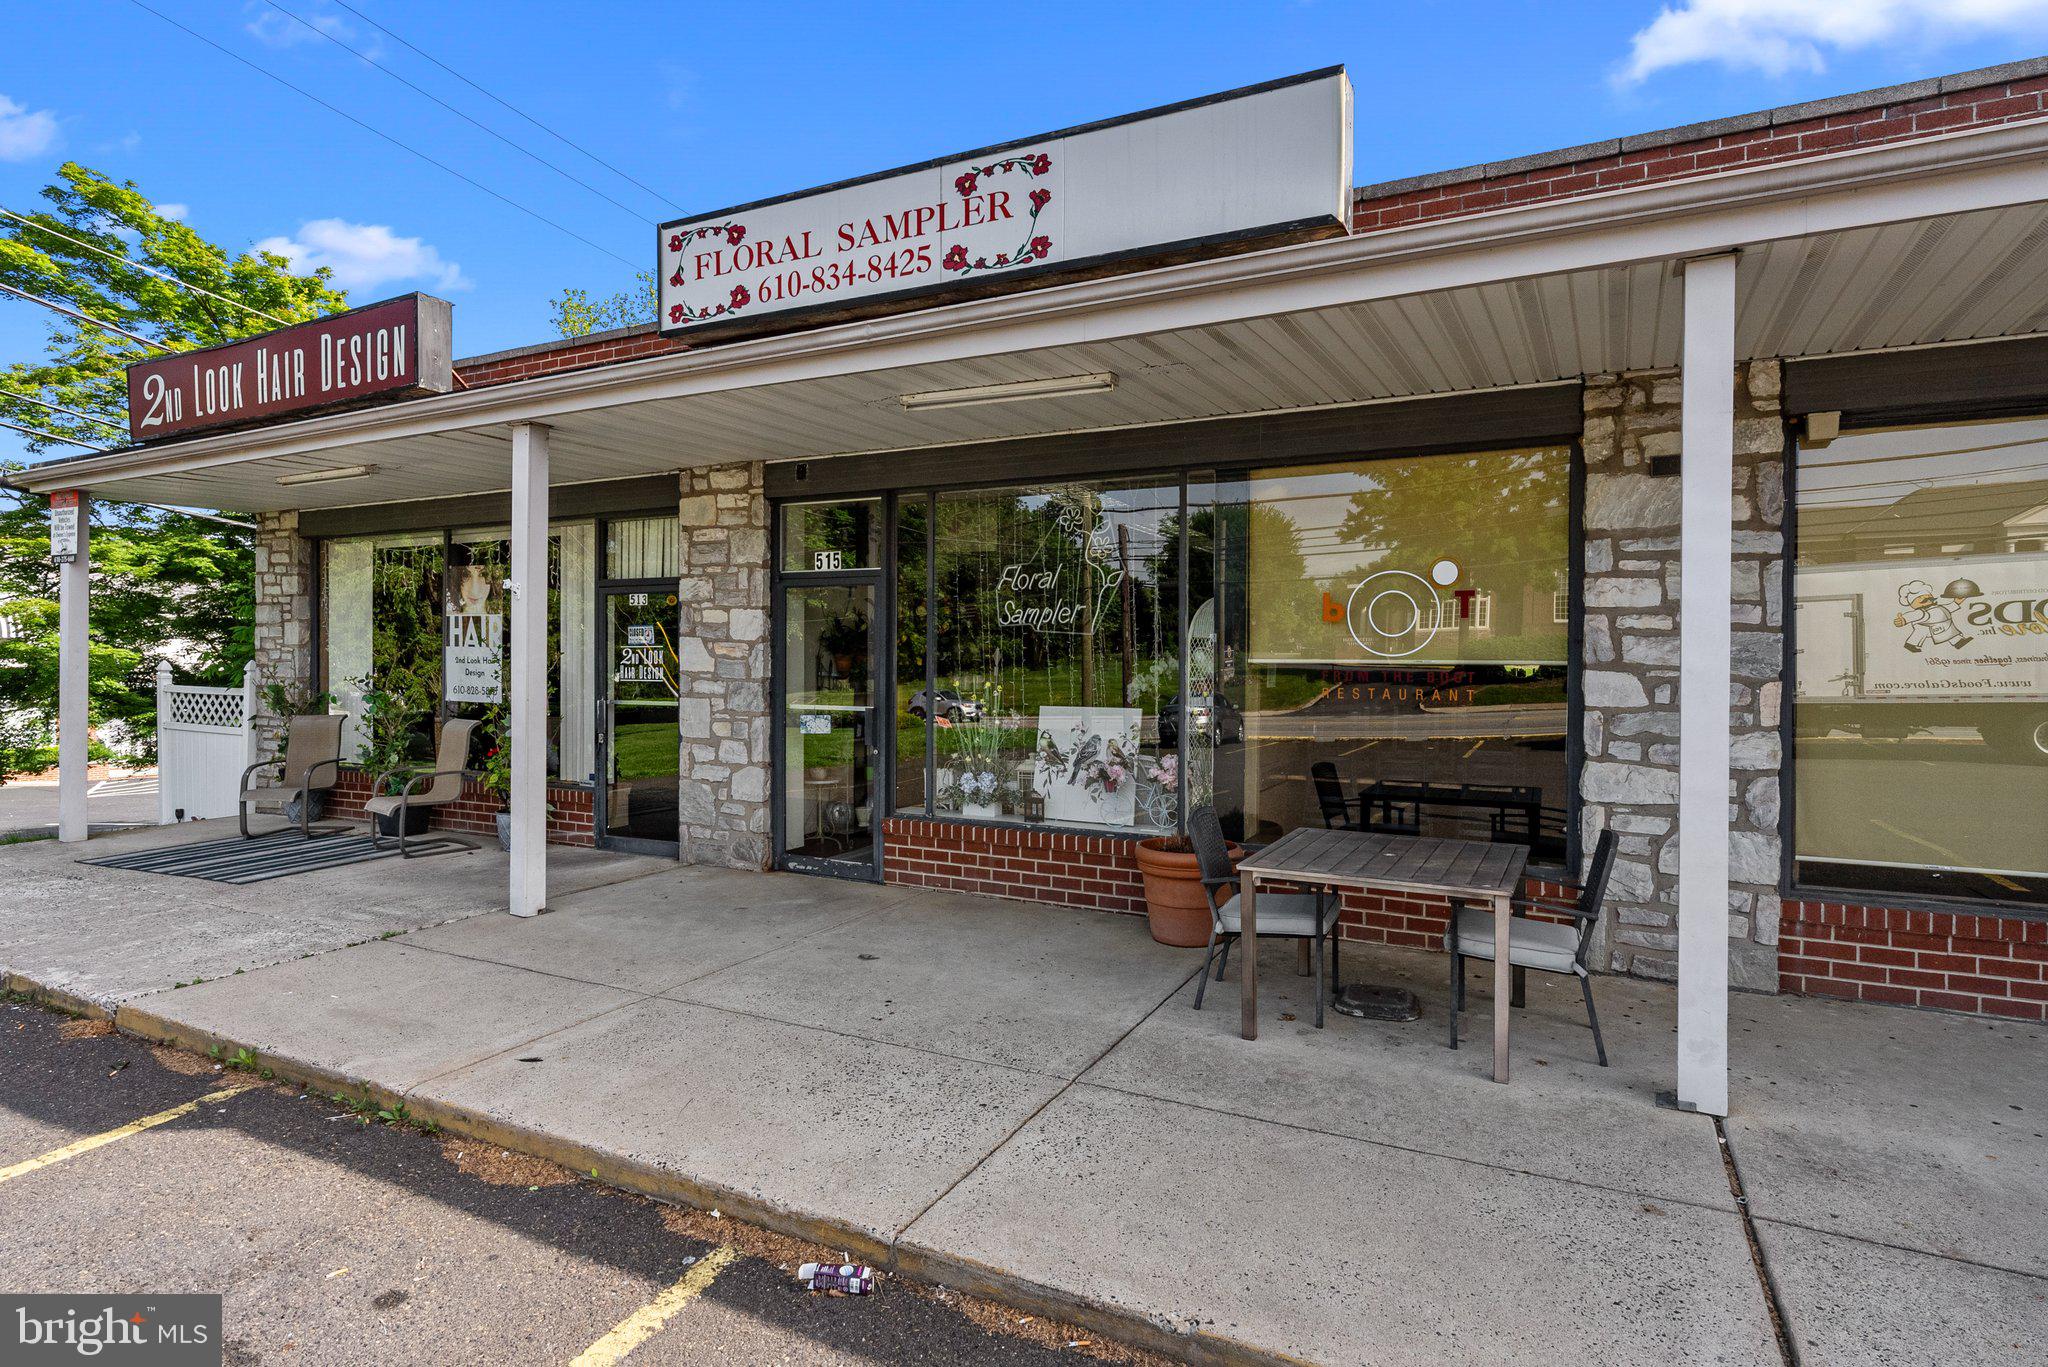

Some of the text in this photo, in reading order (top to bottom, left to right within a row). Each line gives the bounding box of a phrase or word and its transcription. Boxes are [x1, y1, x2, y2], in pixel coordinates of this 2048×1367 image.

[694, 190, 1014, 281] FLORAL SAMPLER
[757, 243, 932, 303] 610-834-8425
[194, 362, 243, 417] LOOK
[257, 348, 305, 404] HAIR
[320, 324, 405, 392] DESIGN
[816, 552, 840, 570] 515
[998, 563, 1062, 591] Floral
[630, 594, 647, 605] 513
[1000, 598, 1086, 631] Sampler
[449, 615, 502, 647] HAIR
[455, 656, 465, 664] 2nd
[467, 656, 480, 664] Look
[465, 668, 485, 678] Design
[1322, 670, 1475, 684] FROM THE BOOT
[1322, 687, 1475, 701] RESTAURANT
